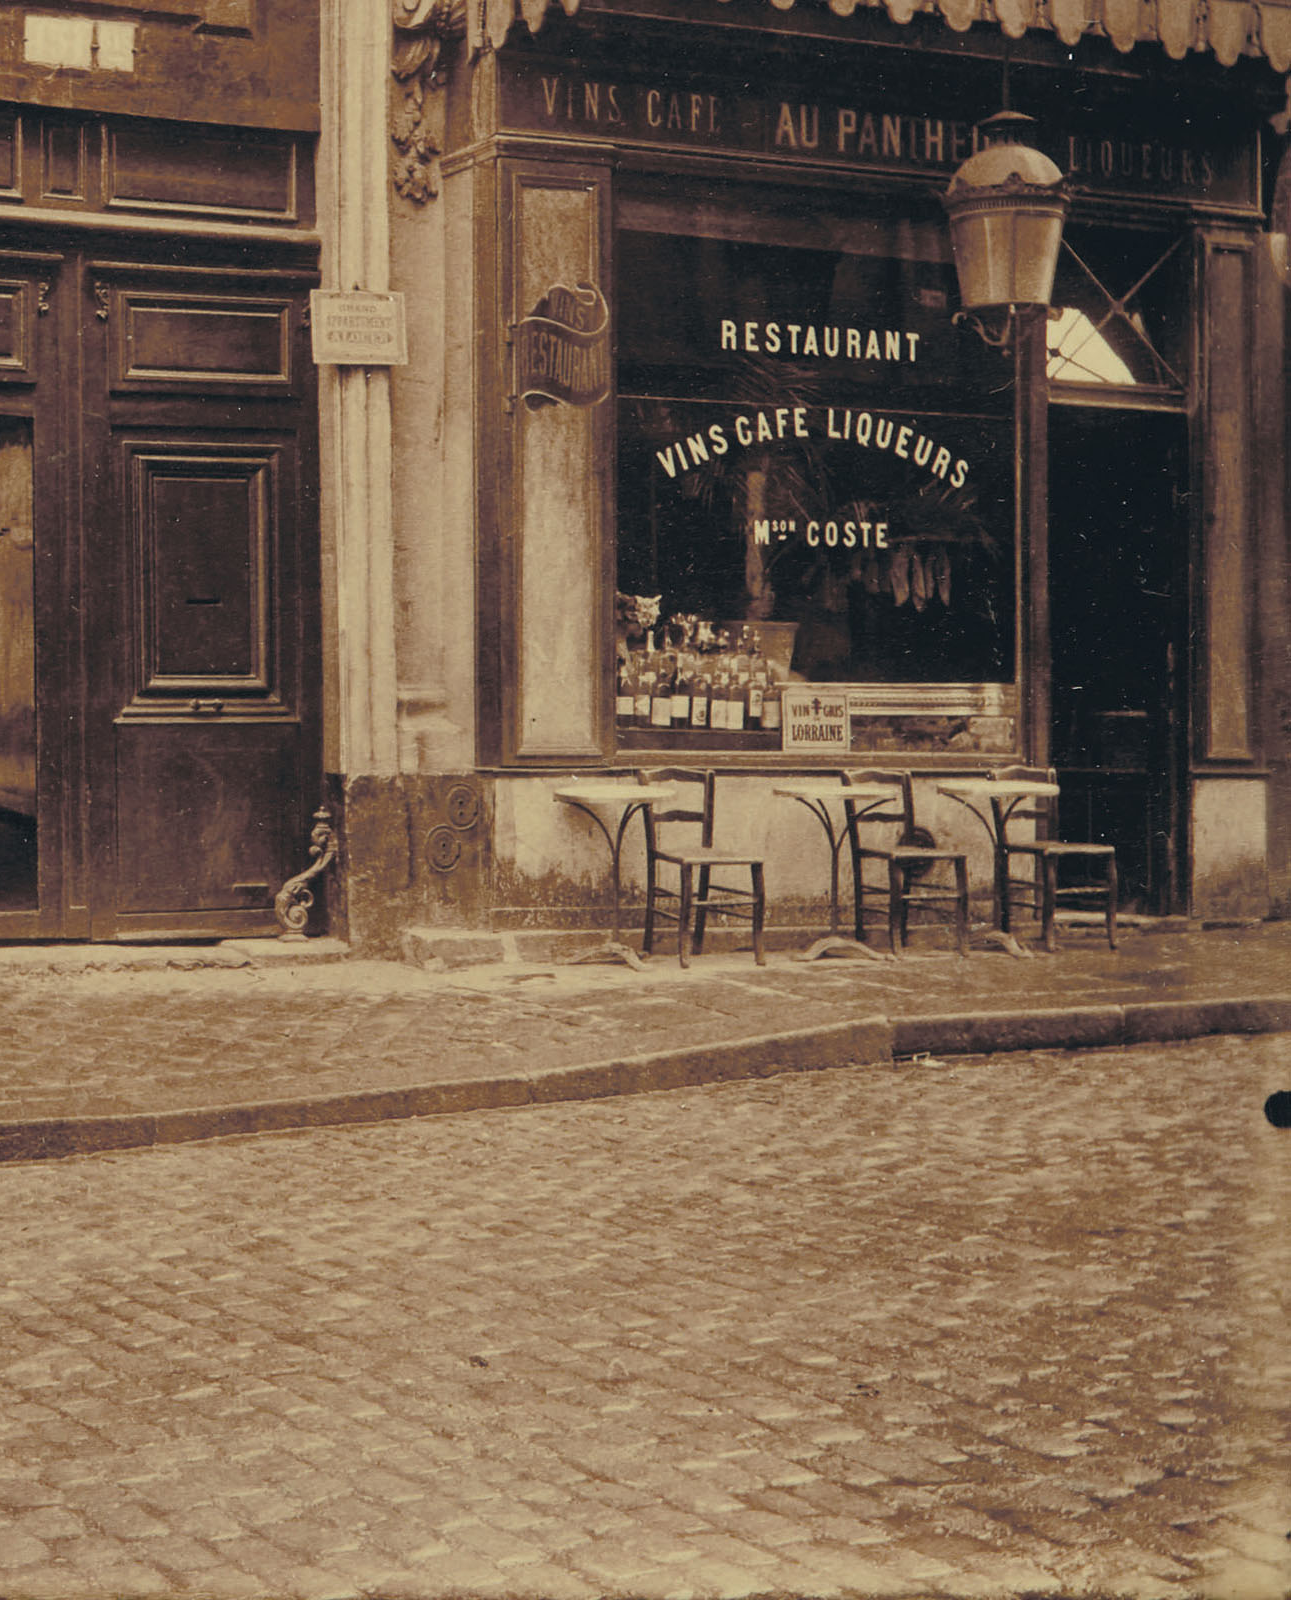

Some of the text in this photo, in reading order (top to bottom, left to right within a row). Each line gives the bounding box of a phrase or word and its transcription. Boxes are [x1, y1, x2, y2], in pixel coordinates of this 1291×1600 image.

[541, 77, 623, 122] VINS
[774, 102, 821, 148] AU
[1067, 135, 1214, 188] LIQUEURS
[550, 293, 587, 330] VINS
[721, 319, 920, 363] RESTAURANT
[520, 331, 608, 392] RESTAURANT
[655, 407, 970, 489] VINS CAFE LIQUEURS
[807, 521, 889, 549] COSTE
[791, 703, 844, 718] VIN GRIS
[791, 723, 844, 742] LORRAINE
